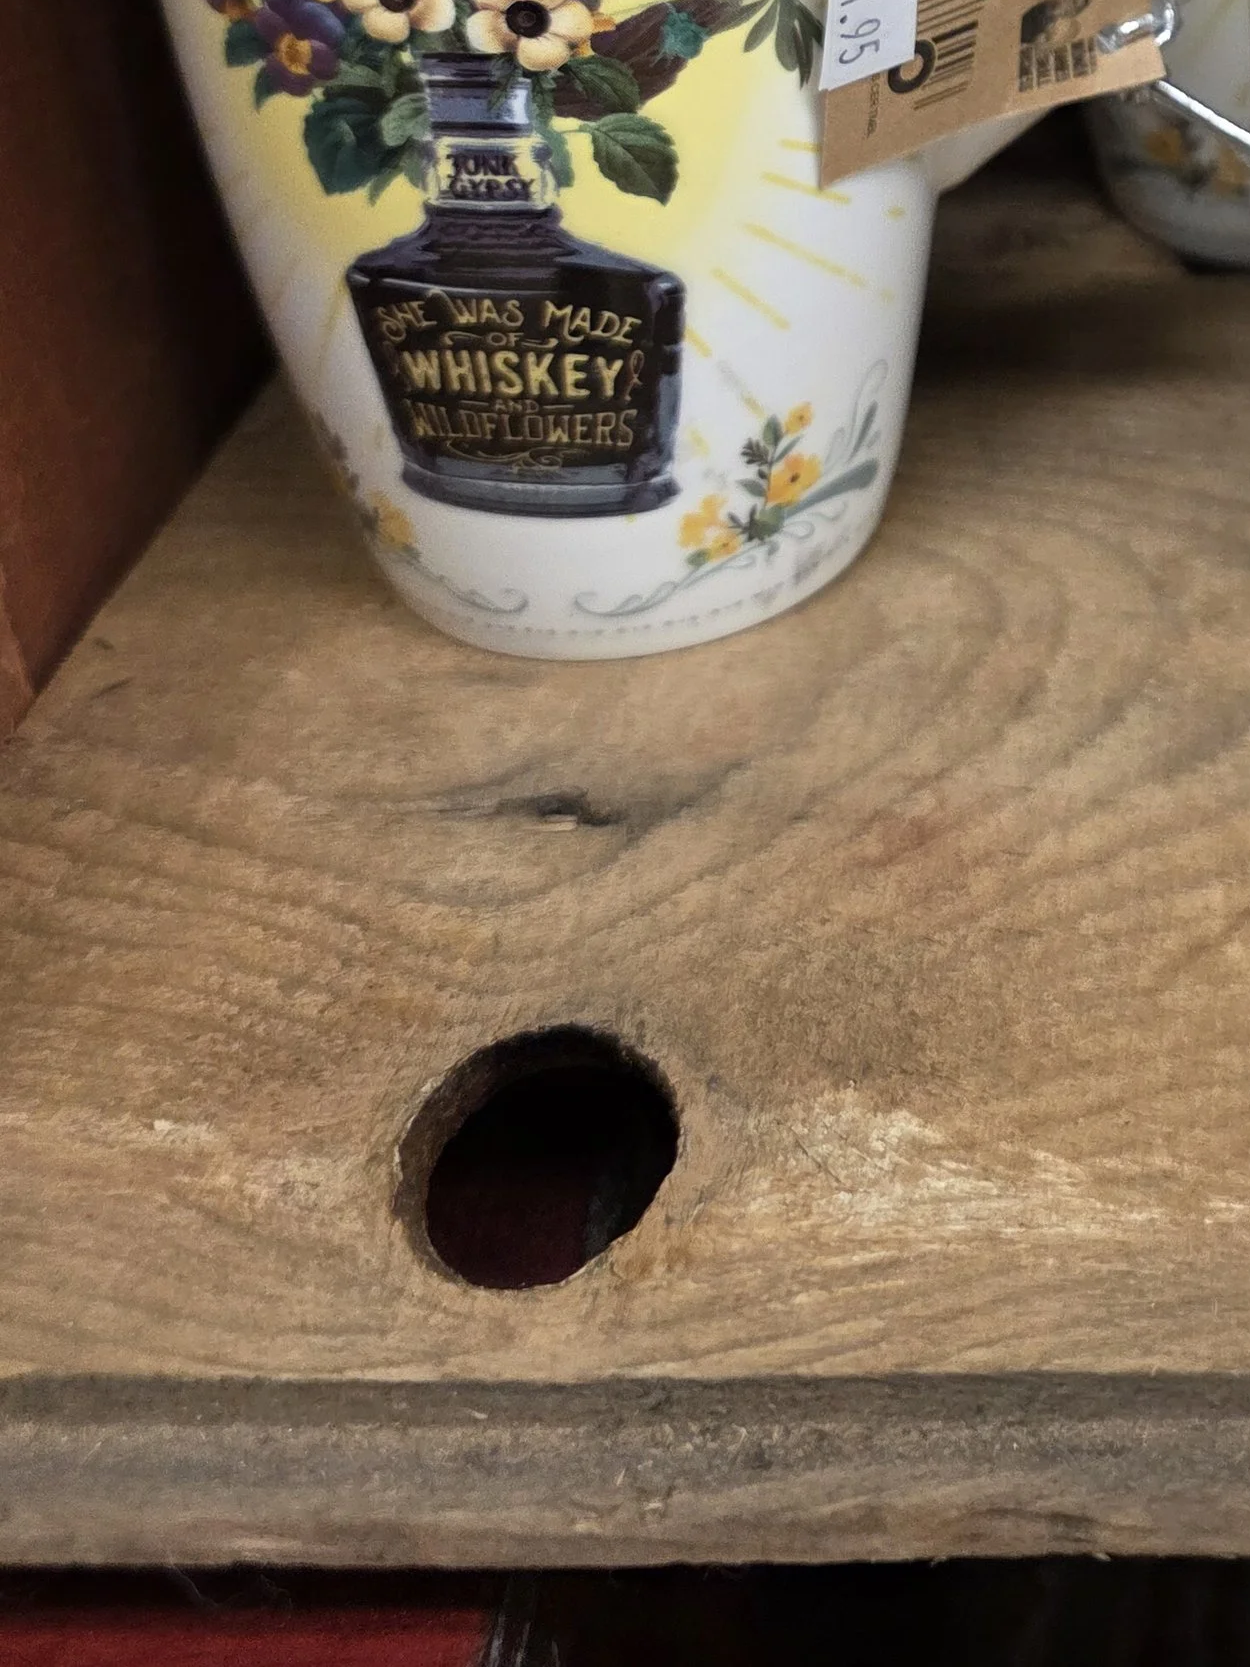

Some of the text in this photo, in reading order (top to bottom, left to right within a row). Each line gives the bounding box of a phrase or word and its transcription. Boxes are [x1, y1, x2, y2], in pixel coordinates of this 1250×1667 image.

[451, 151, 521, 176] JUNK
[449, 175, 535, 200] GYPSY
[374, 290, 641, 344] SHE WAS MADE
[487, 333, 523, 347] OF
[403, 348, 624, 399] WHISKEY
[492, 399, 539, 414] AND
[406, 399, 637, 446] WILDFLOWERS
